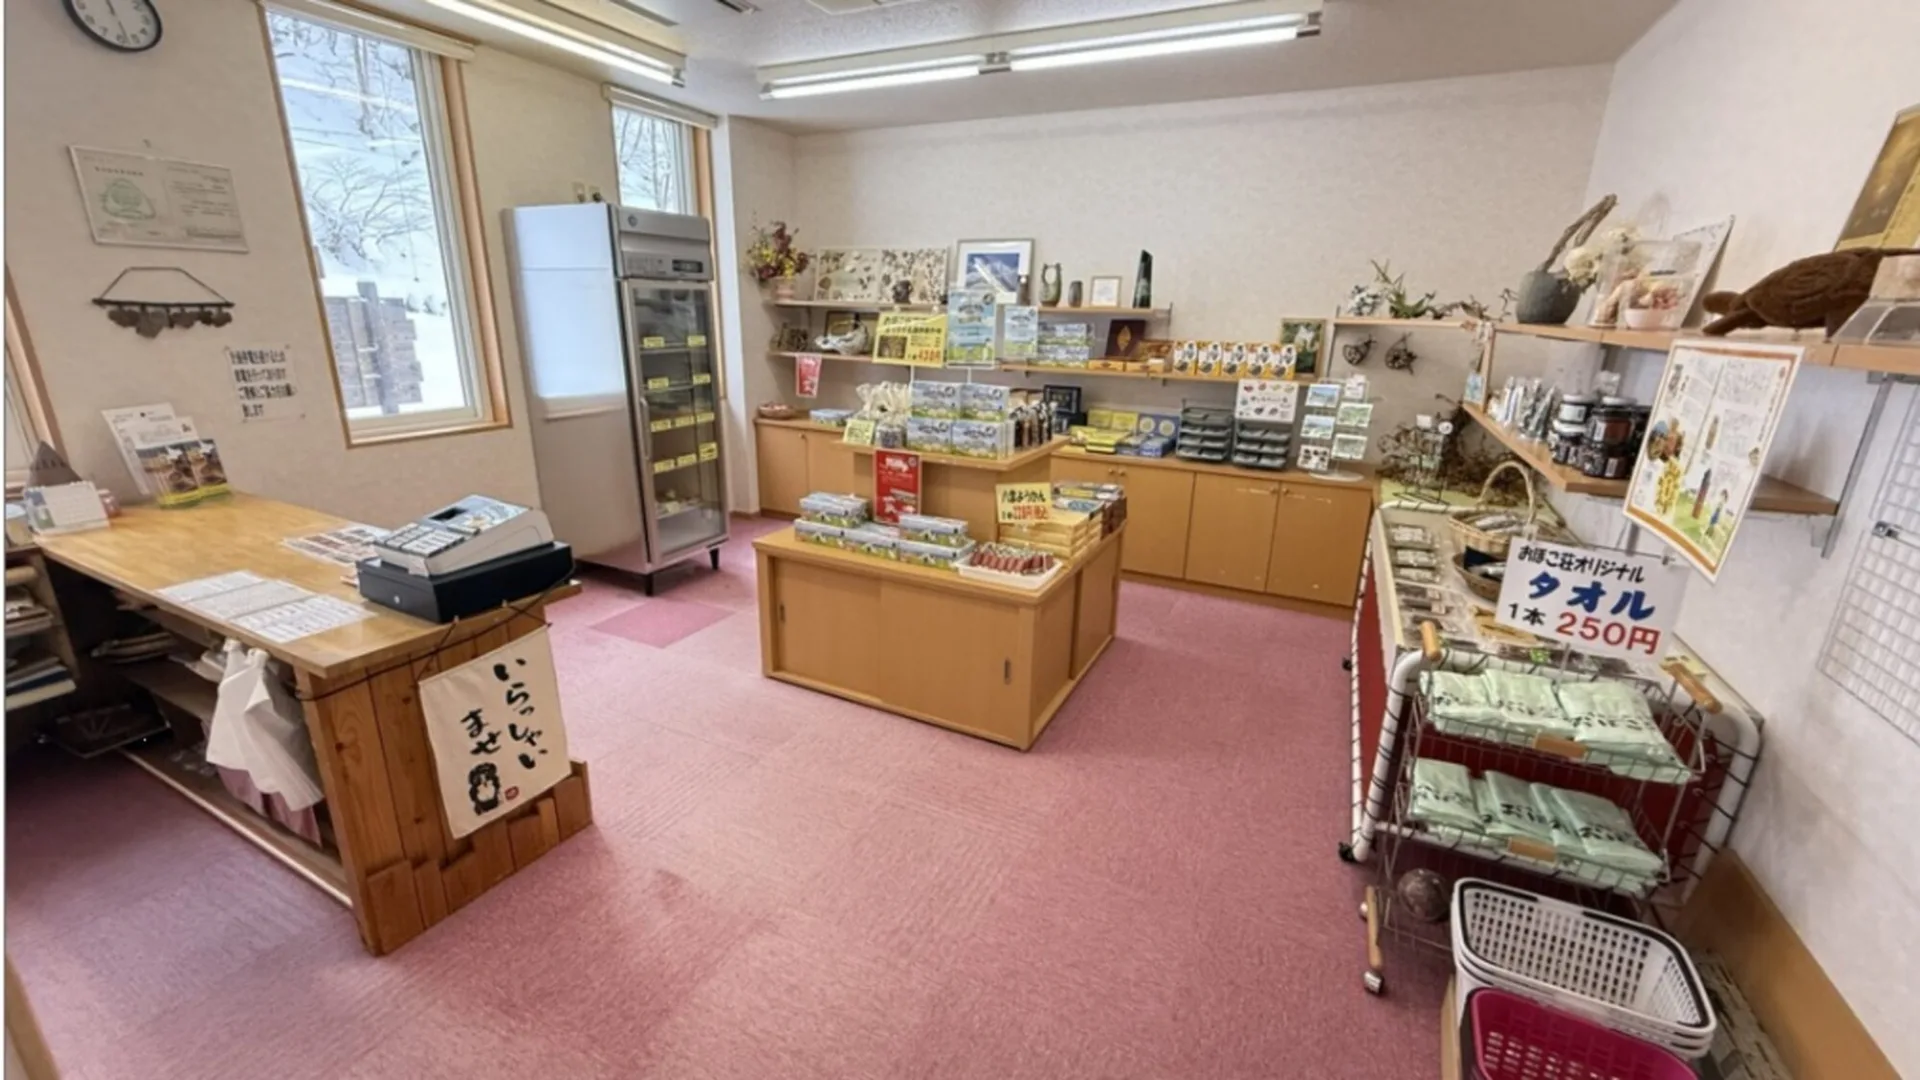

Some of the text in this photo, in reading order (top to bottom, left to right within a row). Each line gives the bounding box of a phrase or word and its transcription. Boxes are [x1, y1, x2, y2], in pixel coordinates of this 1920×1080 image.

[1529, 571, 1655, 620] タオル
[1508, 602, 1661, 655] 1本 250円
[460, 708, 502, 755] ませ
[493, 657, 548, 770] いらっしゃい
